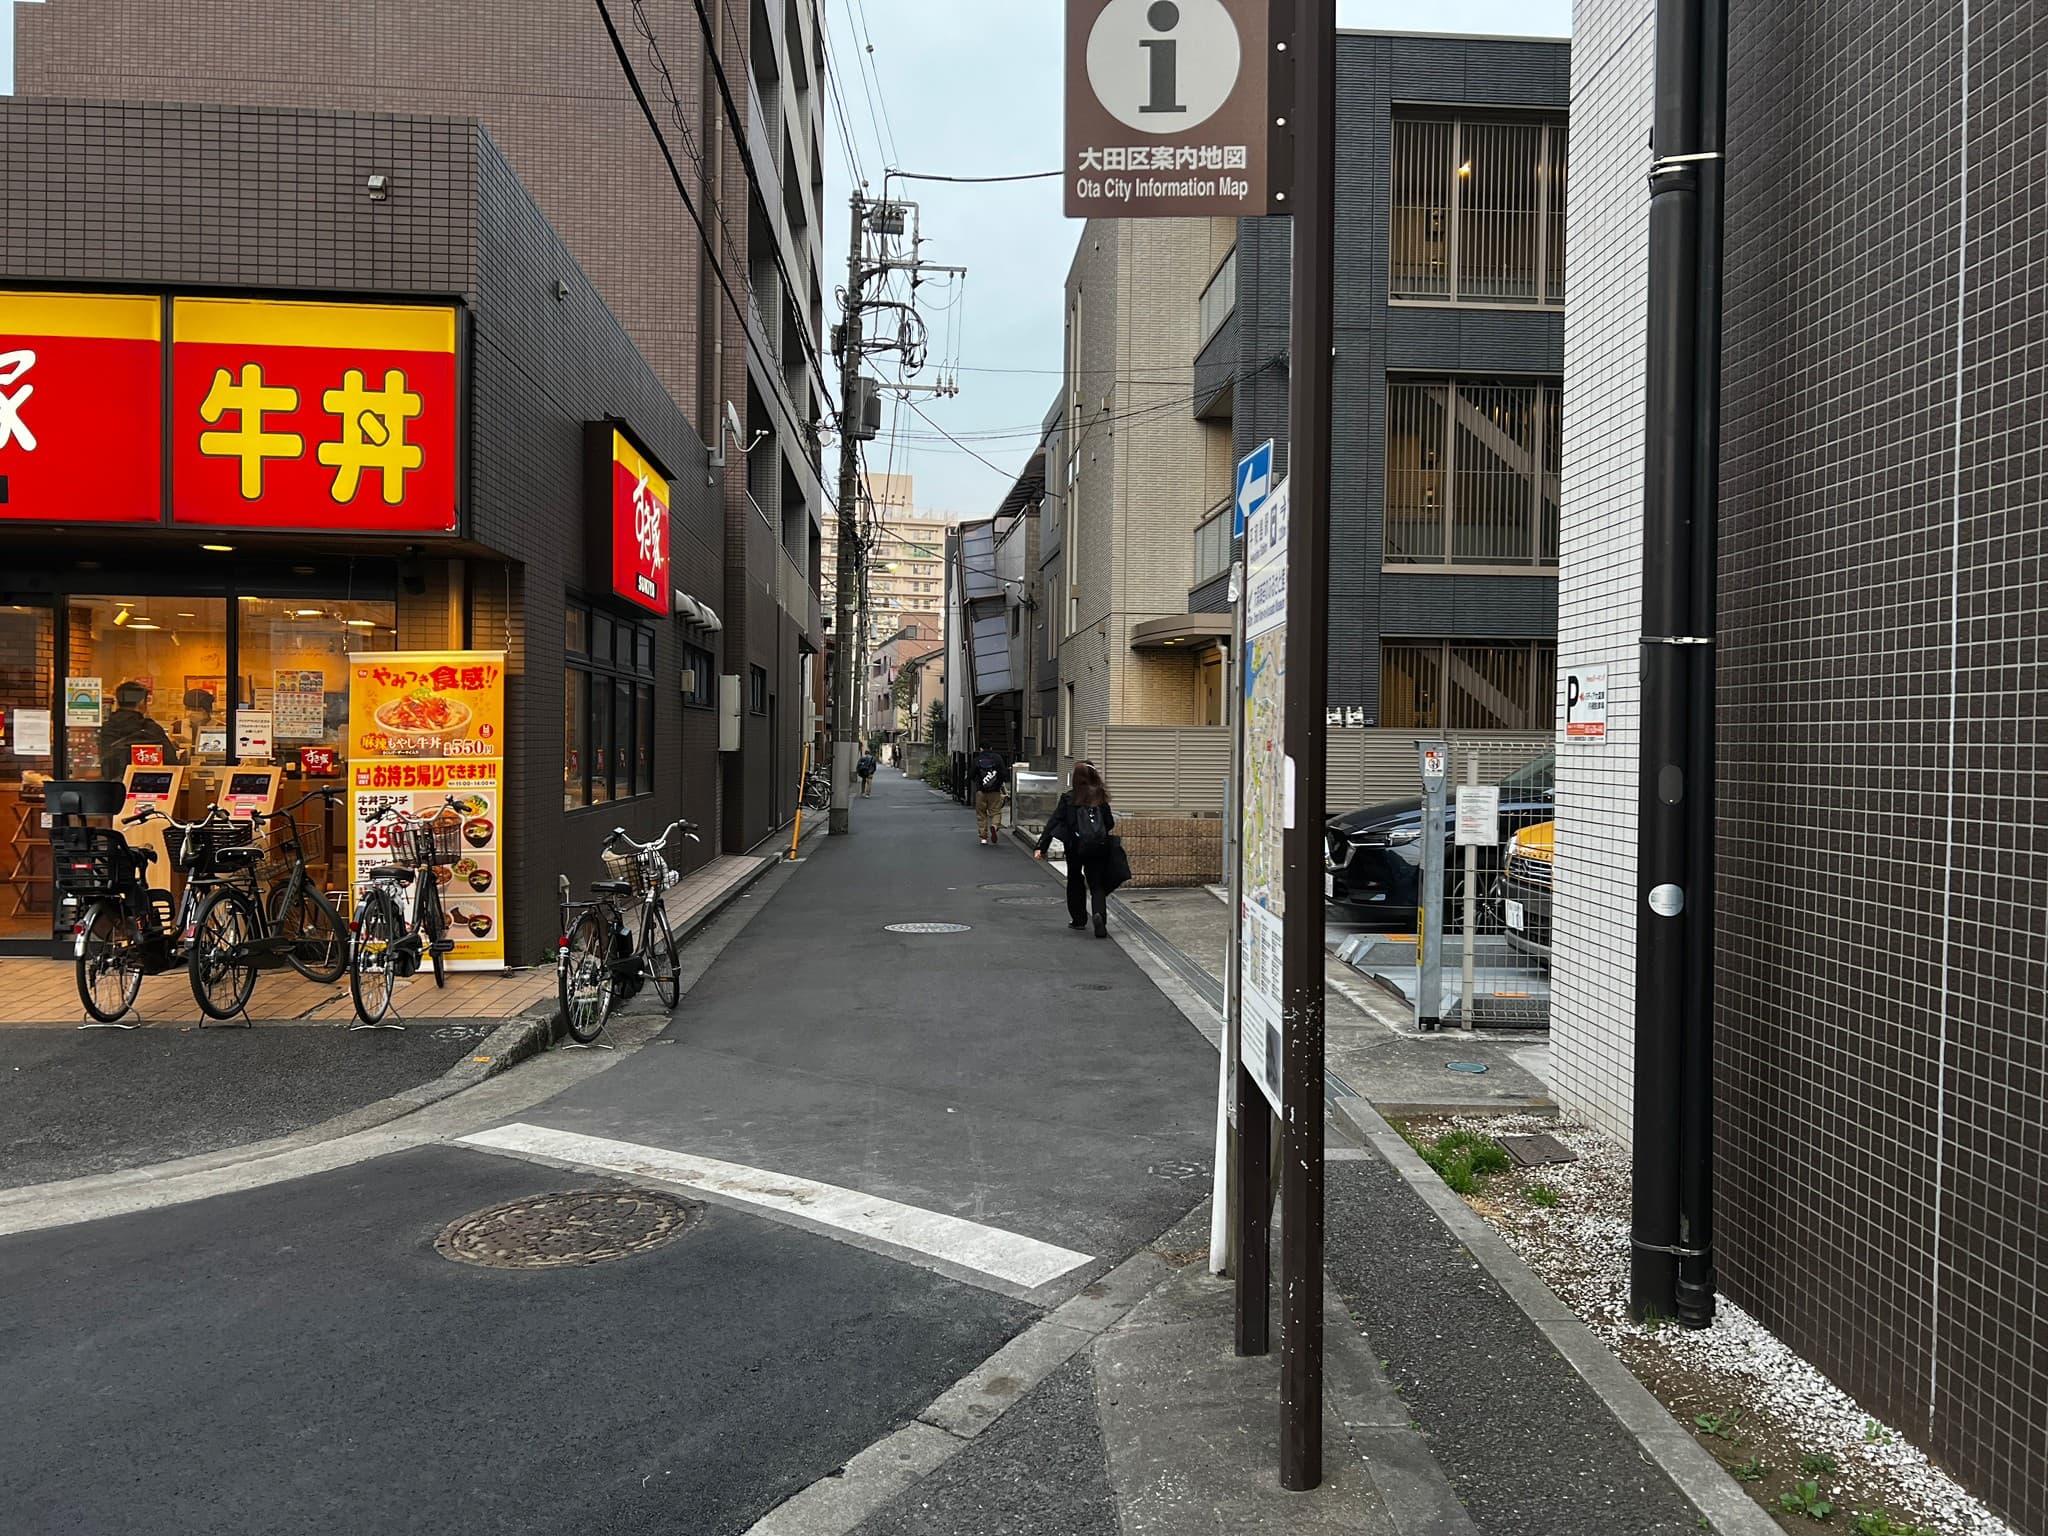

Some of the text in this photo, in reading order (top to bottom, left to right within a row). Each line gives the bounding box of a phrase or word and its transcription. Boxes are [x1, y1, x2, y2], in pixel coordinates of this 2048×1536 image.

[1078, 145, 1247, 171] 大田区案内地図
[1077, 175, 1248, 202] Ota City Information Map
[199, 362, 424, 505] 牛丼
[632, 458, 662, 578] すき家
[1567, 675, 1580, 723] P
[358, 795, 409, 806] 牛丼ランチ
